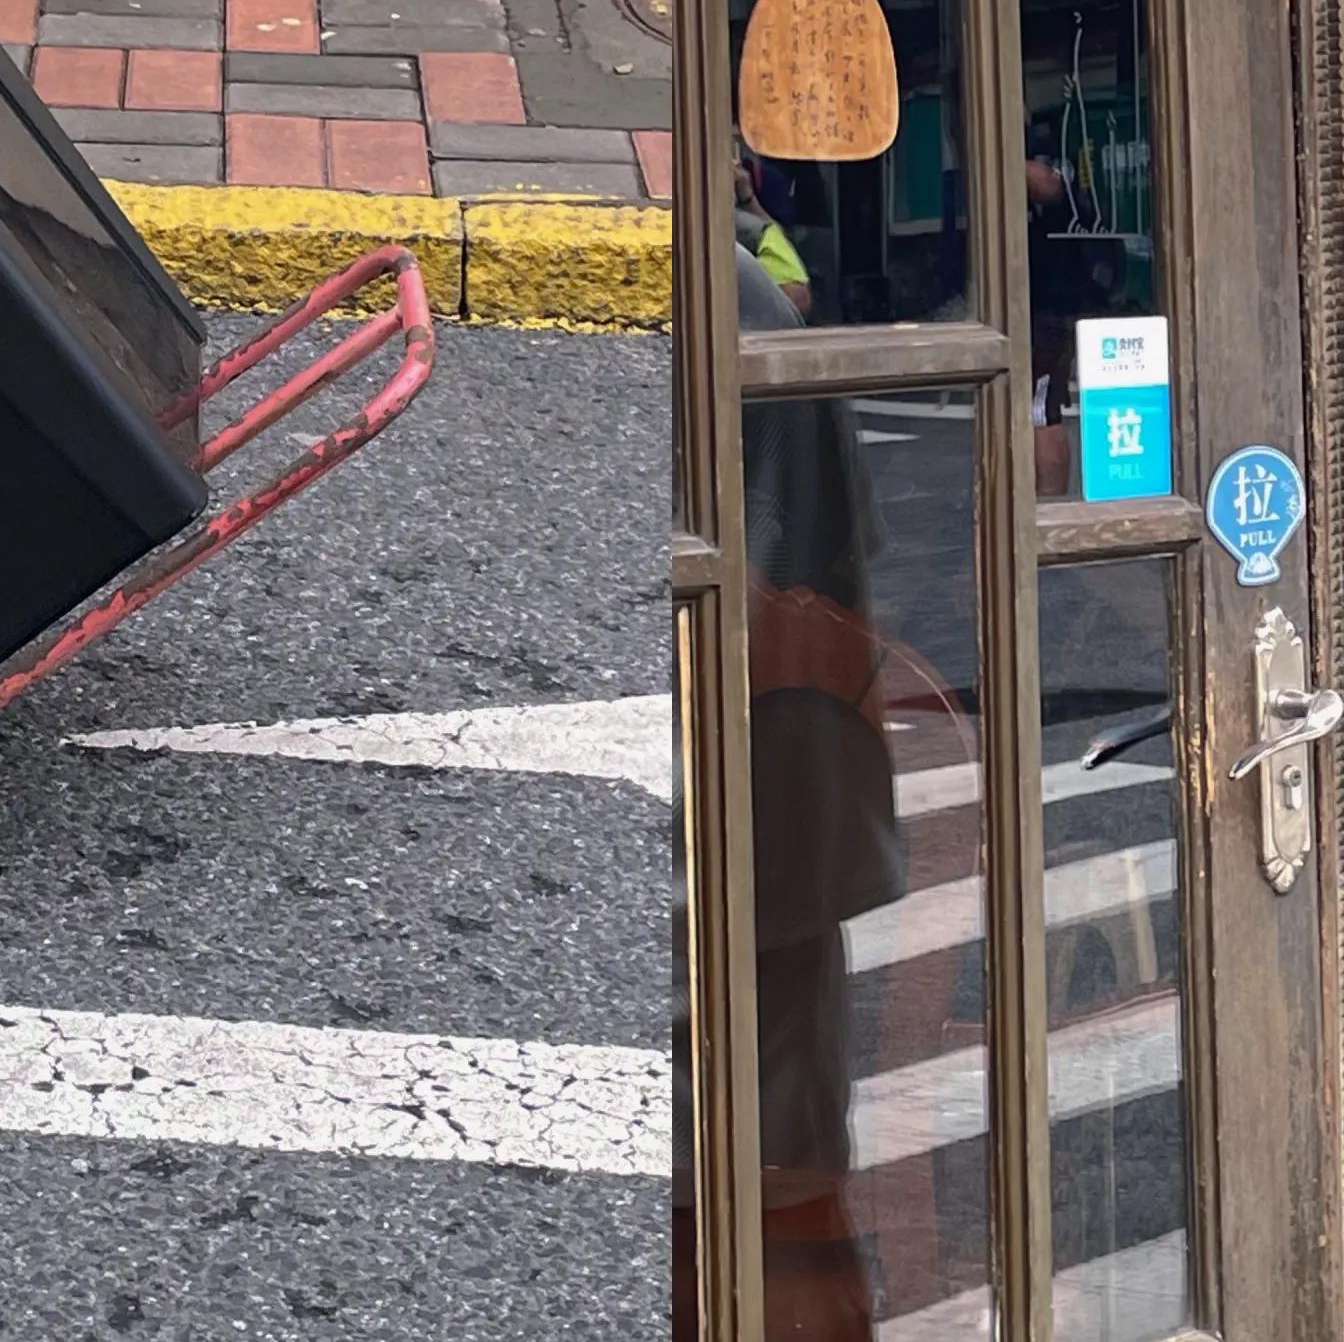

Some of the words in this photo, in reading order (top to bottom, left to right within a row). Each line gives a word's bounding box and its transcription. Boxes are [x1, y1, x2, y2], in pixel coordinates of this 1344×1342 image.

[1107, 406, 1145, 458] 拉
[1108, 463, 1144, 480] PULL
[1232, 464, 1281, 526] 拉
[1239, 530, 1277, 548] PULL
